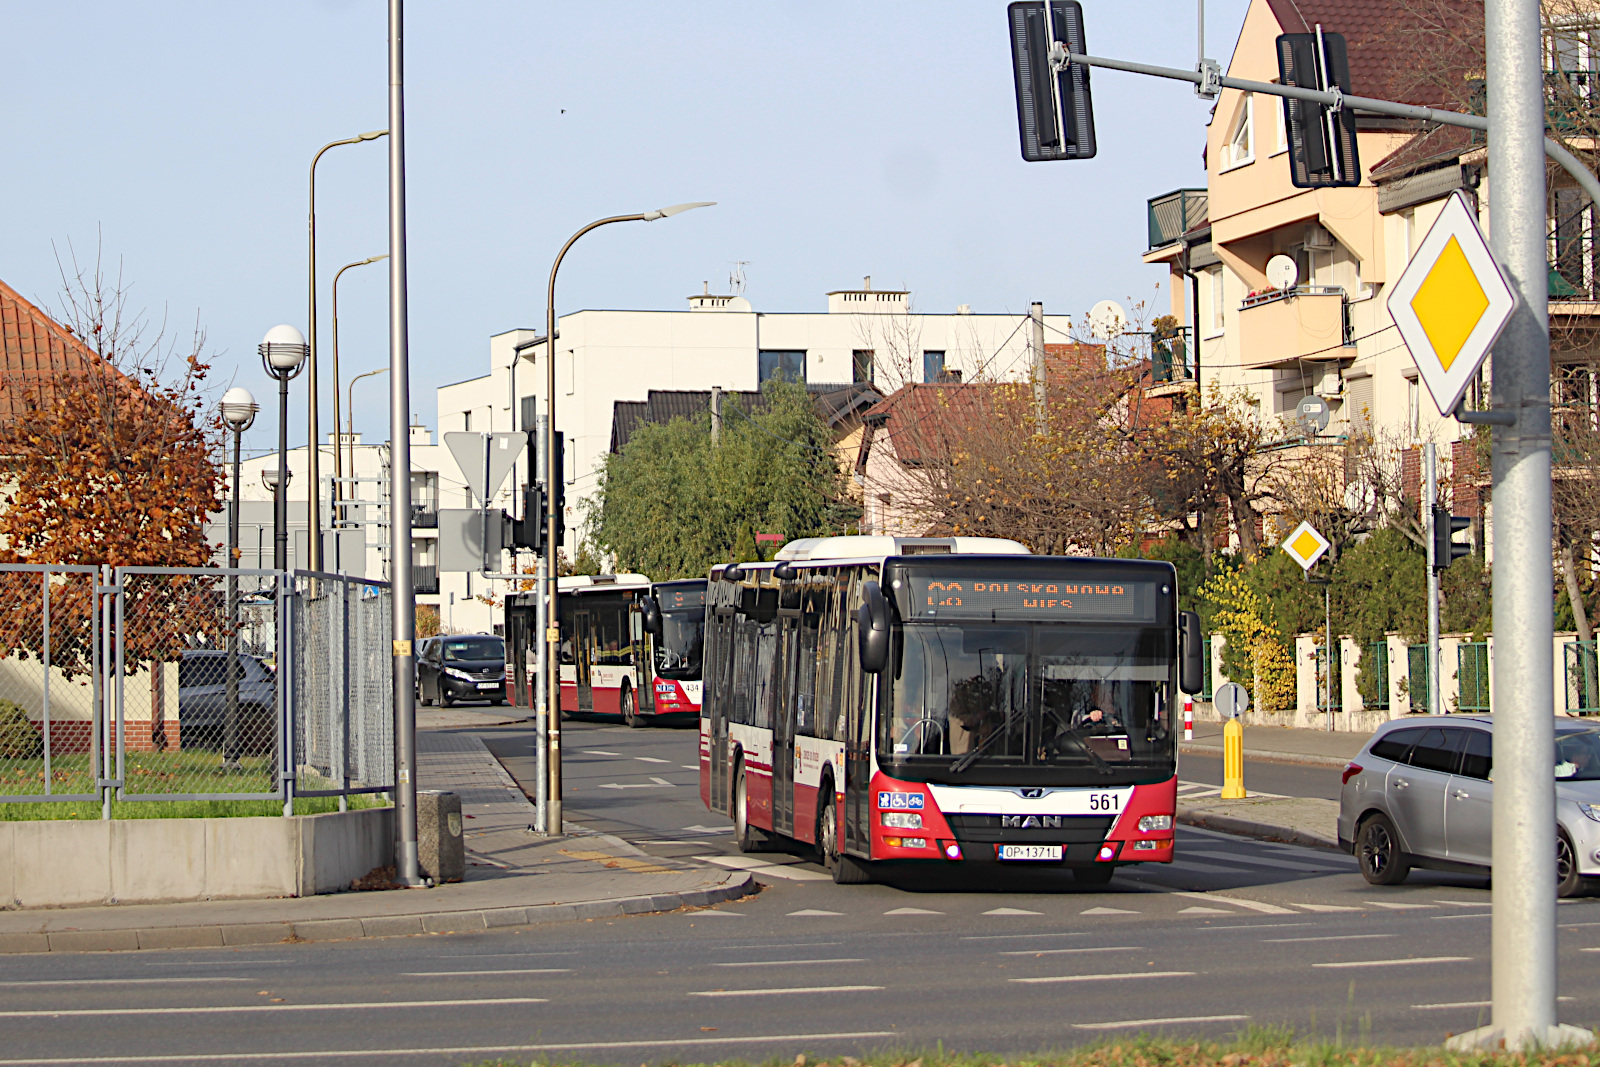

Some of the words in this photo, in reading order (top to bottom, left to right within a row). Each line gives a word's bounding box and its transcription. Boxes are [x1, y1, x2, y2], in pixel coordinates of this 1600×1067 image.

[685, 683, 699, 692] 434
[1089, 793, 1119, 811] 561
[1001, 814, 1062, 828] MAN
